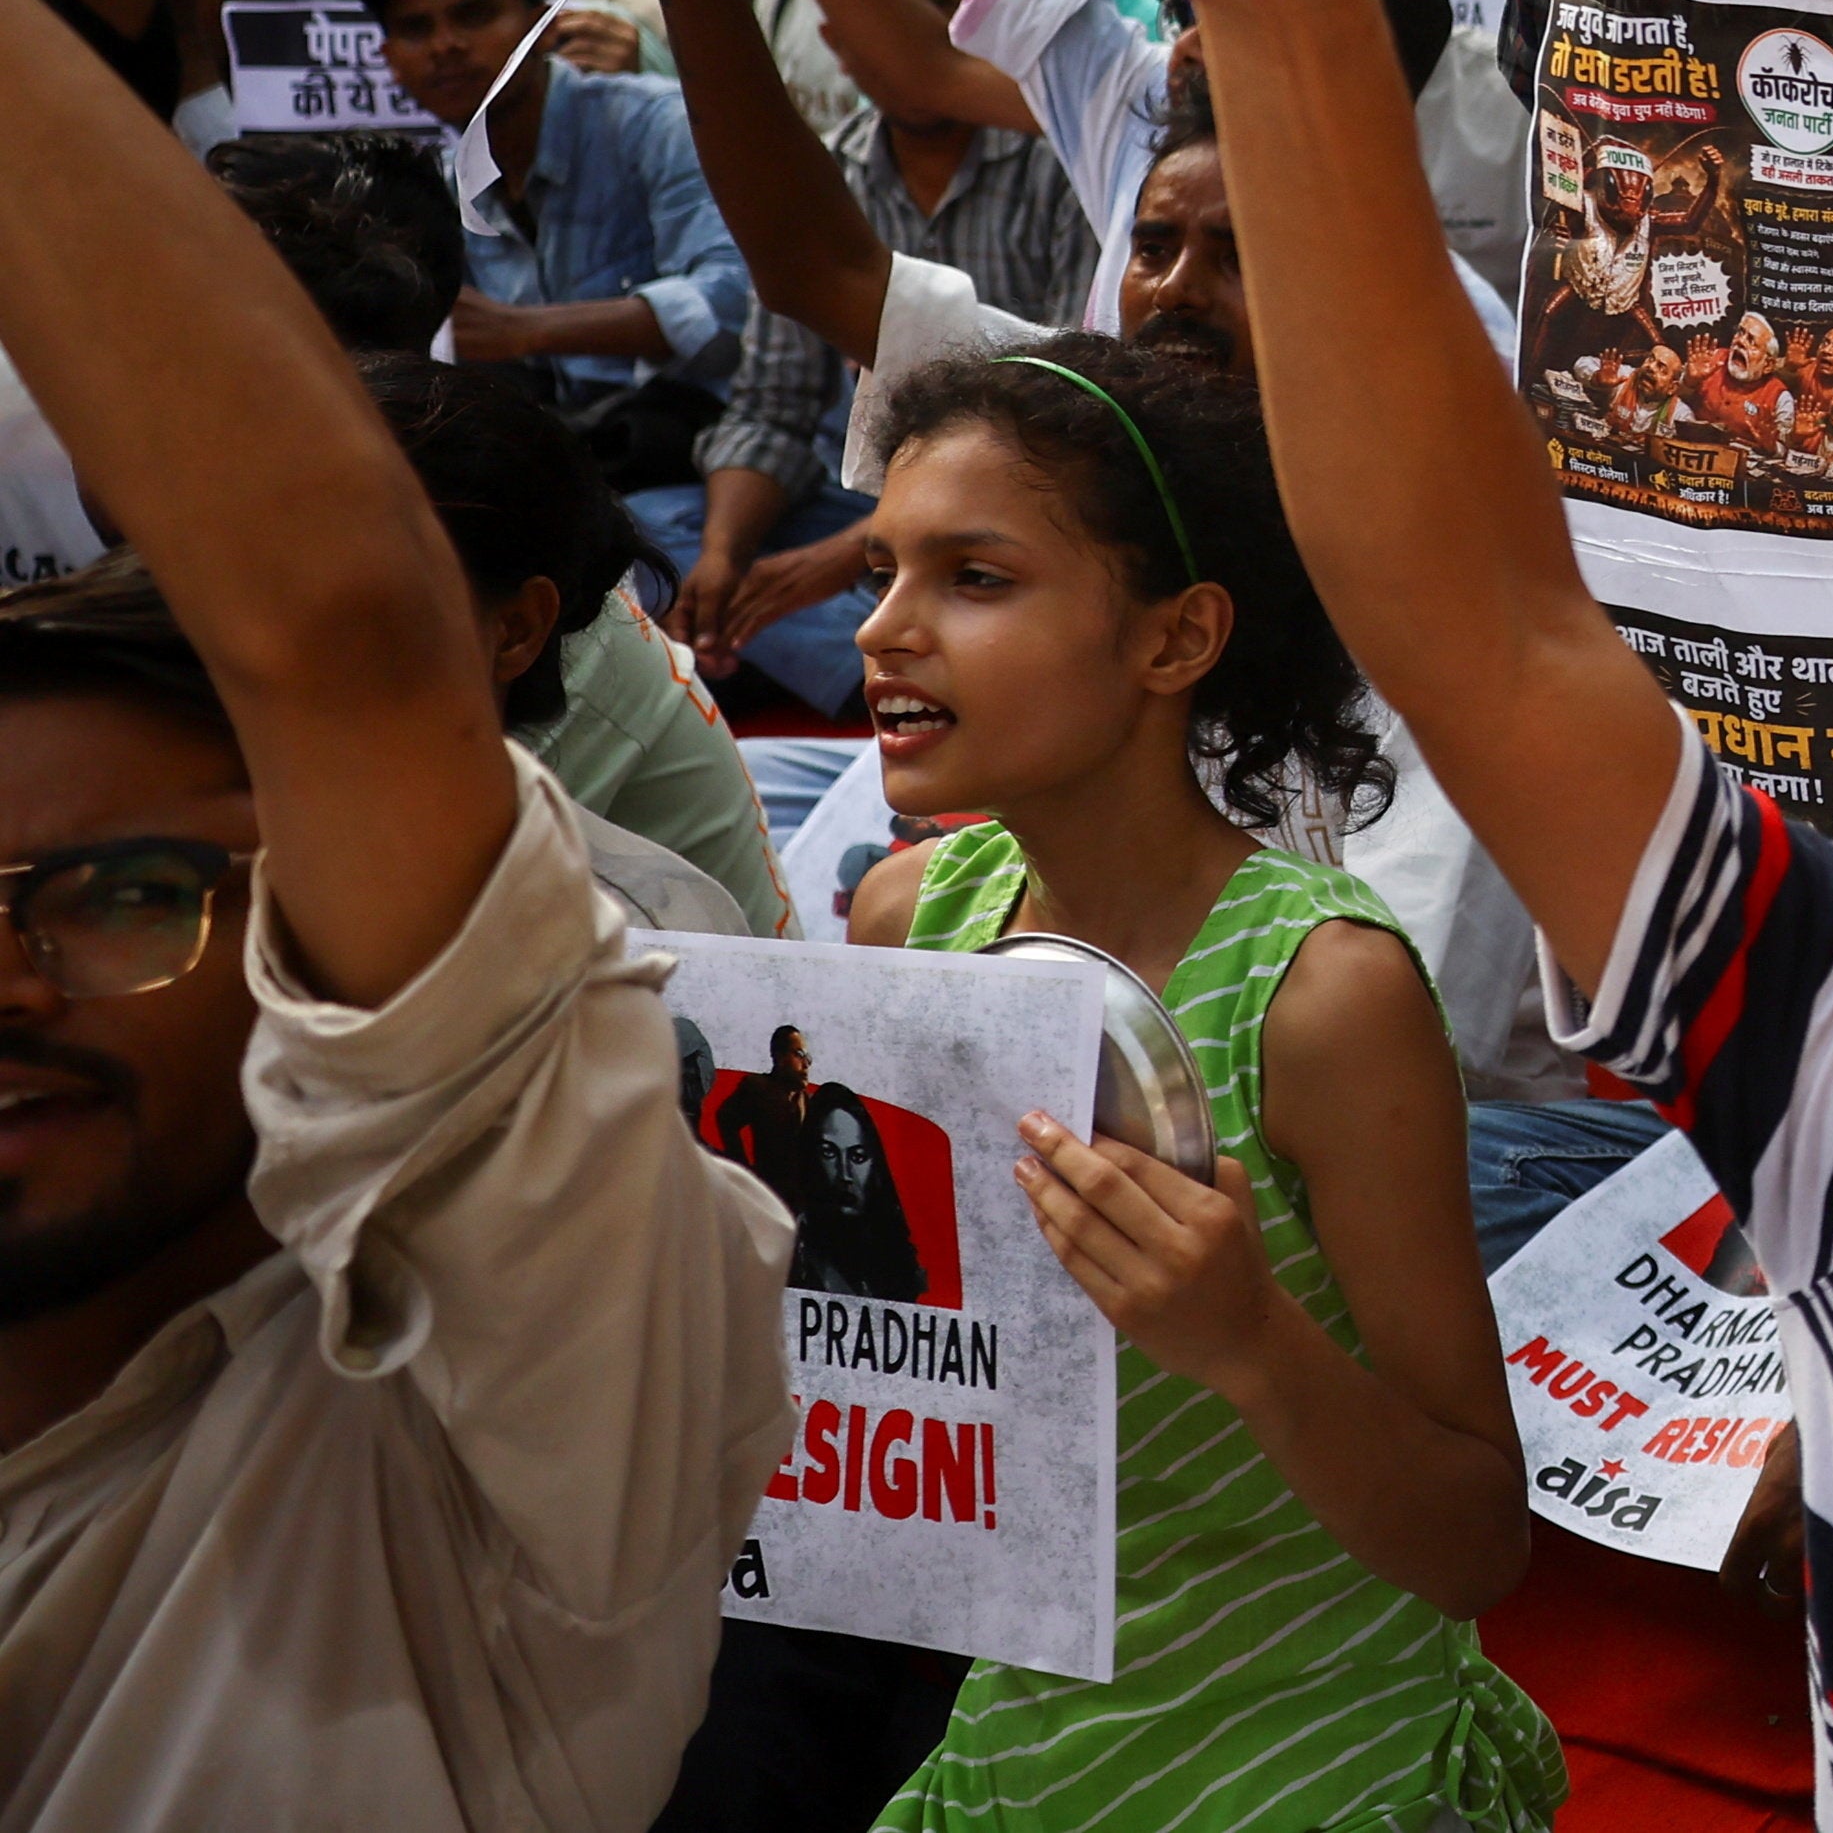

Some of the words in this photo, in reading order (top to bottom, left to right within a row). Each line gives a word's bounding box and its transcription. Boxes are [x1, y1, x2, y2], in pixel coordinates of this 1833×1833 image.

[1605, 148, 1644, 169] YOUTH
[1761, 108, 1799, 131] जनता
[1802, 112, 1833, 136] पार्टी
[1670, 636, 1730, 672] ताली
[1734, 645, 1787, 682] और
[1680, 670, 1741, 705] बजते
[1747, 679, 1783, 721] हुए
[1615, 1253, 1782, 1347] DHARME
[799, 1297, 999, 1391] PRADHAN
[1505, 1336, 1650, 1432] MUST
[764, 1395, 998, 1530] SIGN!
[1536, 1456, 1664, 1533] aisa
